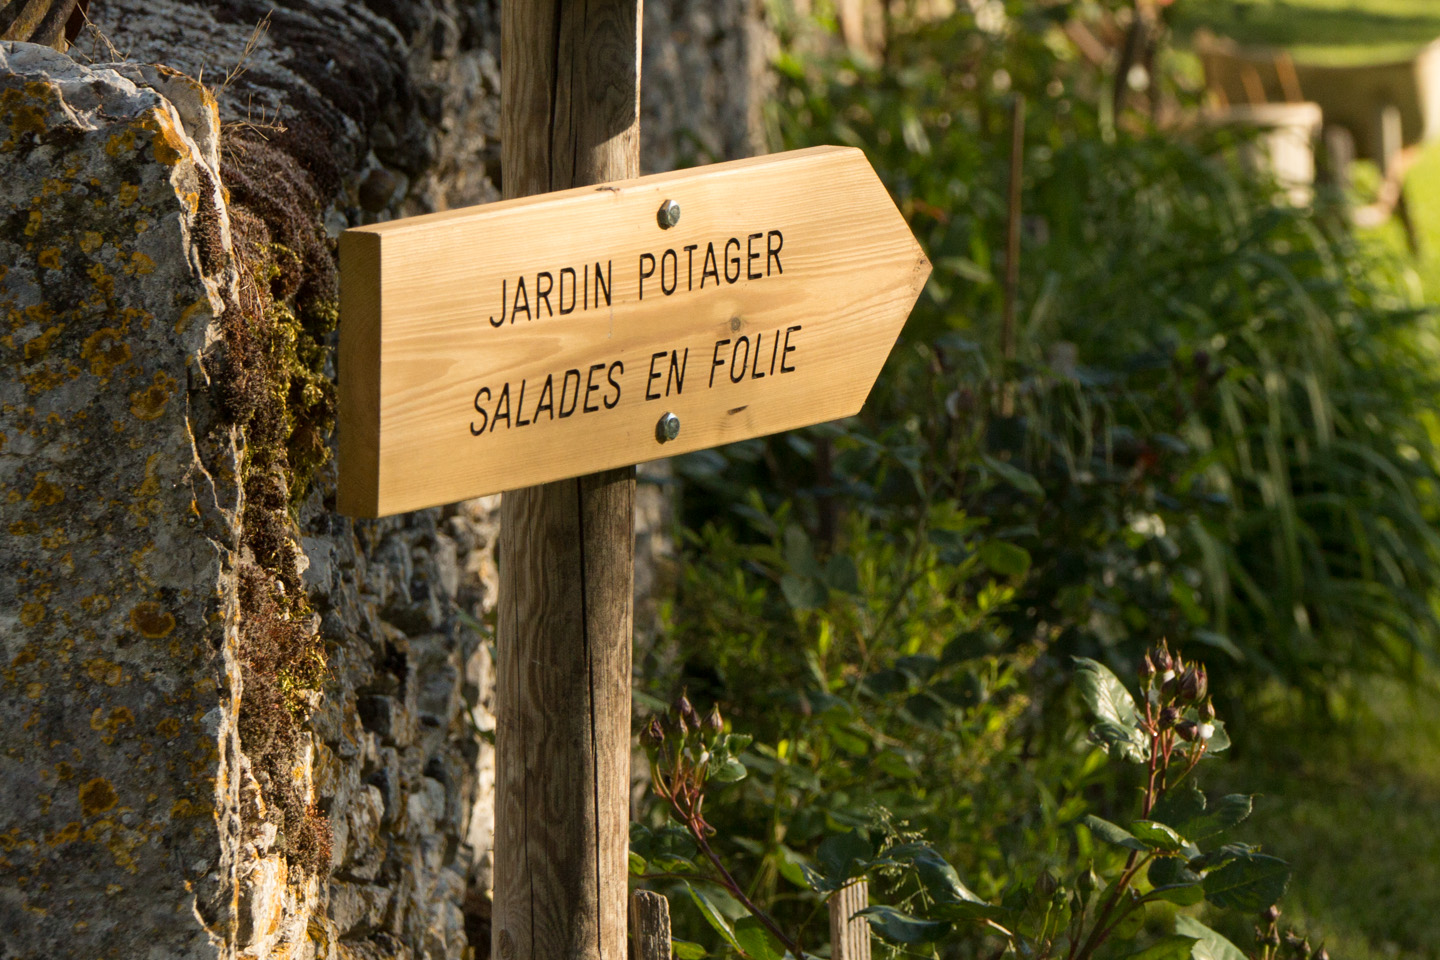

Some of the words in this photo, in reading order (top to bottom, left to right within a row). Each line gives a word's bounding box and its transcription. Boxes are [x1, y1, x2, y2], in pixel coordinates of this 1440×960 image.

[489, 259, 612, 328] JARDIN
[638, 230, 784, 301] POTAGER
[470, 360, 624, 436] SALADES
[645, 347, 689, 401] EN
[708, 325, 802, 389] FOLIE
